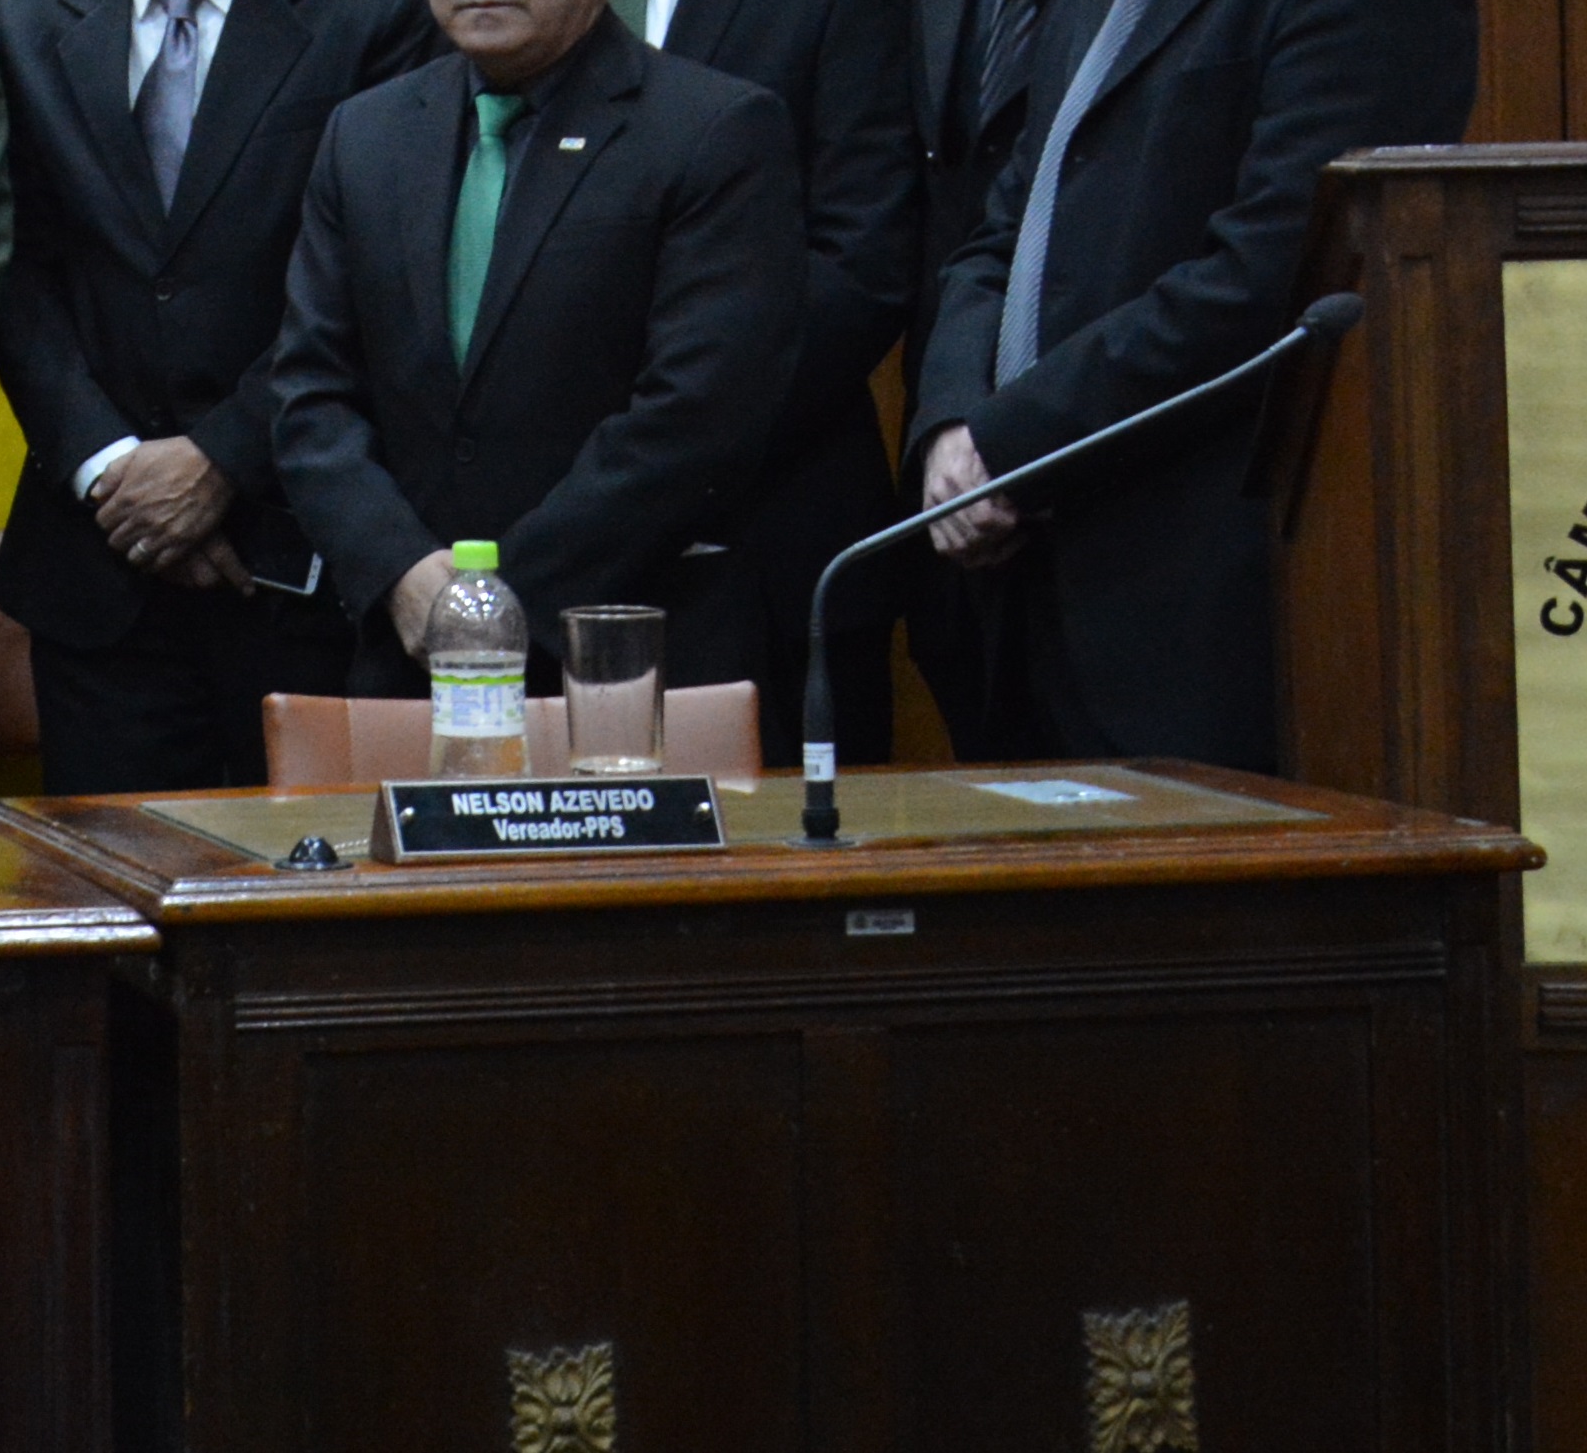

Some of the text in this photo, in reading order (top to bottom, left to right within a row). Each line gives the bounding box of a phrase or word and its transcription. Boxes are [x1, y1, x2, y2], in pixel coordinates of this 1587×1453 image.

[450, 788, 655, 816] NELSON AZEVEDO
[492, 815, 626, 842] Vereador-PPS
